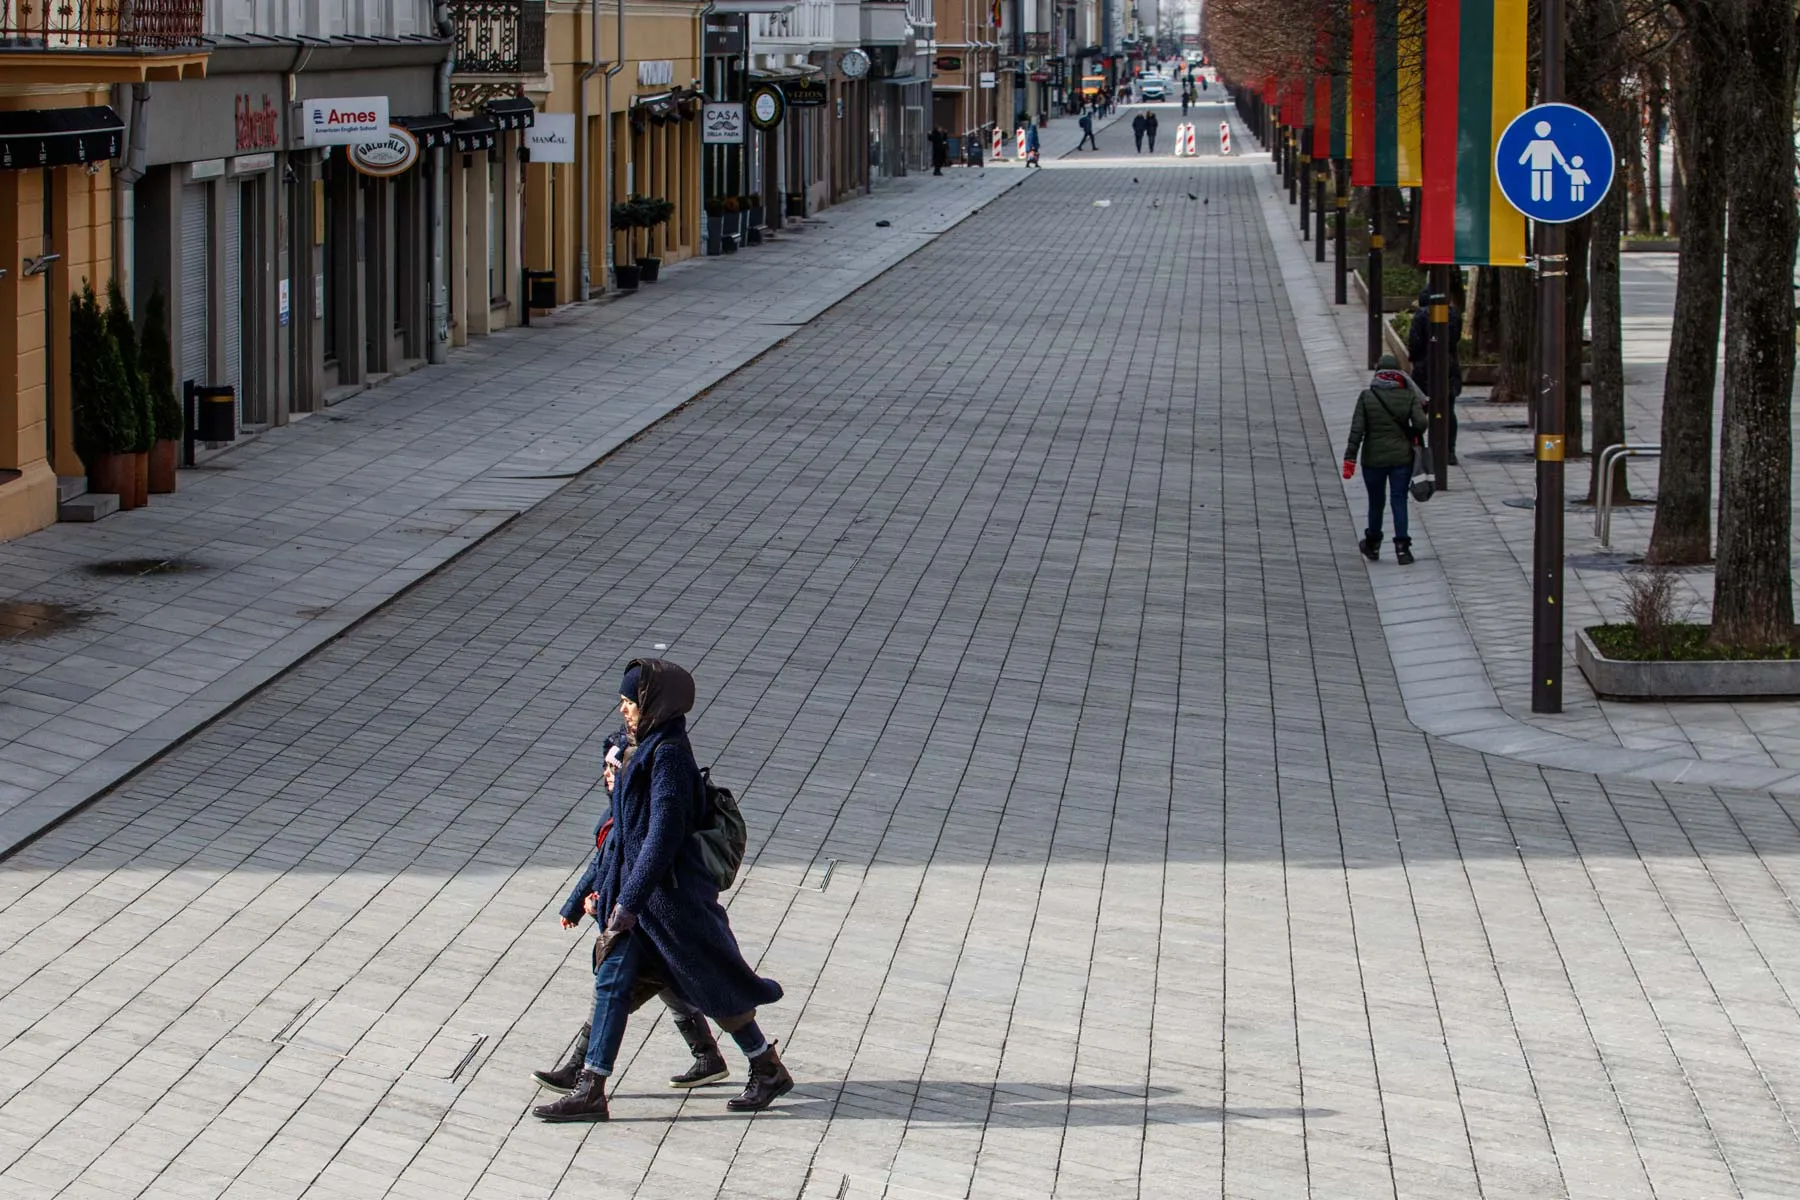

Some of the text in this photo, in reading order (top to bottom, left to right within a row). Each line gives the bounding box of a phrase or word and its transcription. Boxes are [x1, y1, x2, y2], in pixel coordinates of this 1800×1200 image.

[327, 109, 376, 124] Ames
[707, 110, 739, 120] CASA
[532, 133, 567, 144] MANGAL
